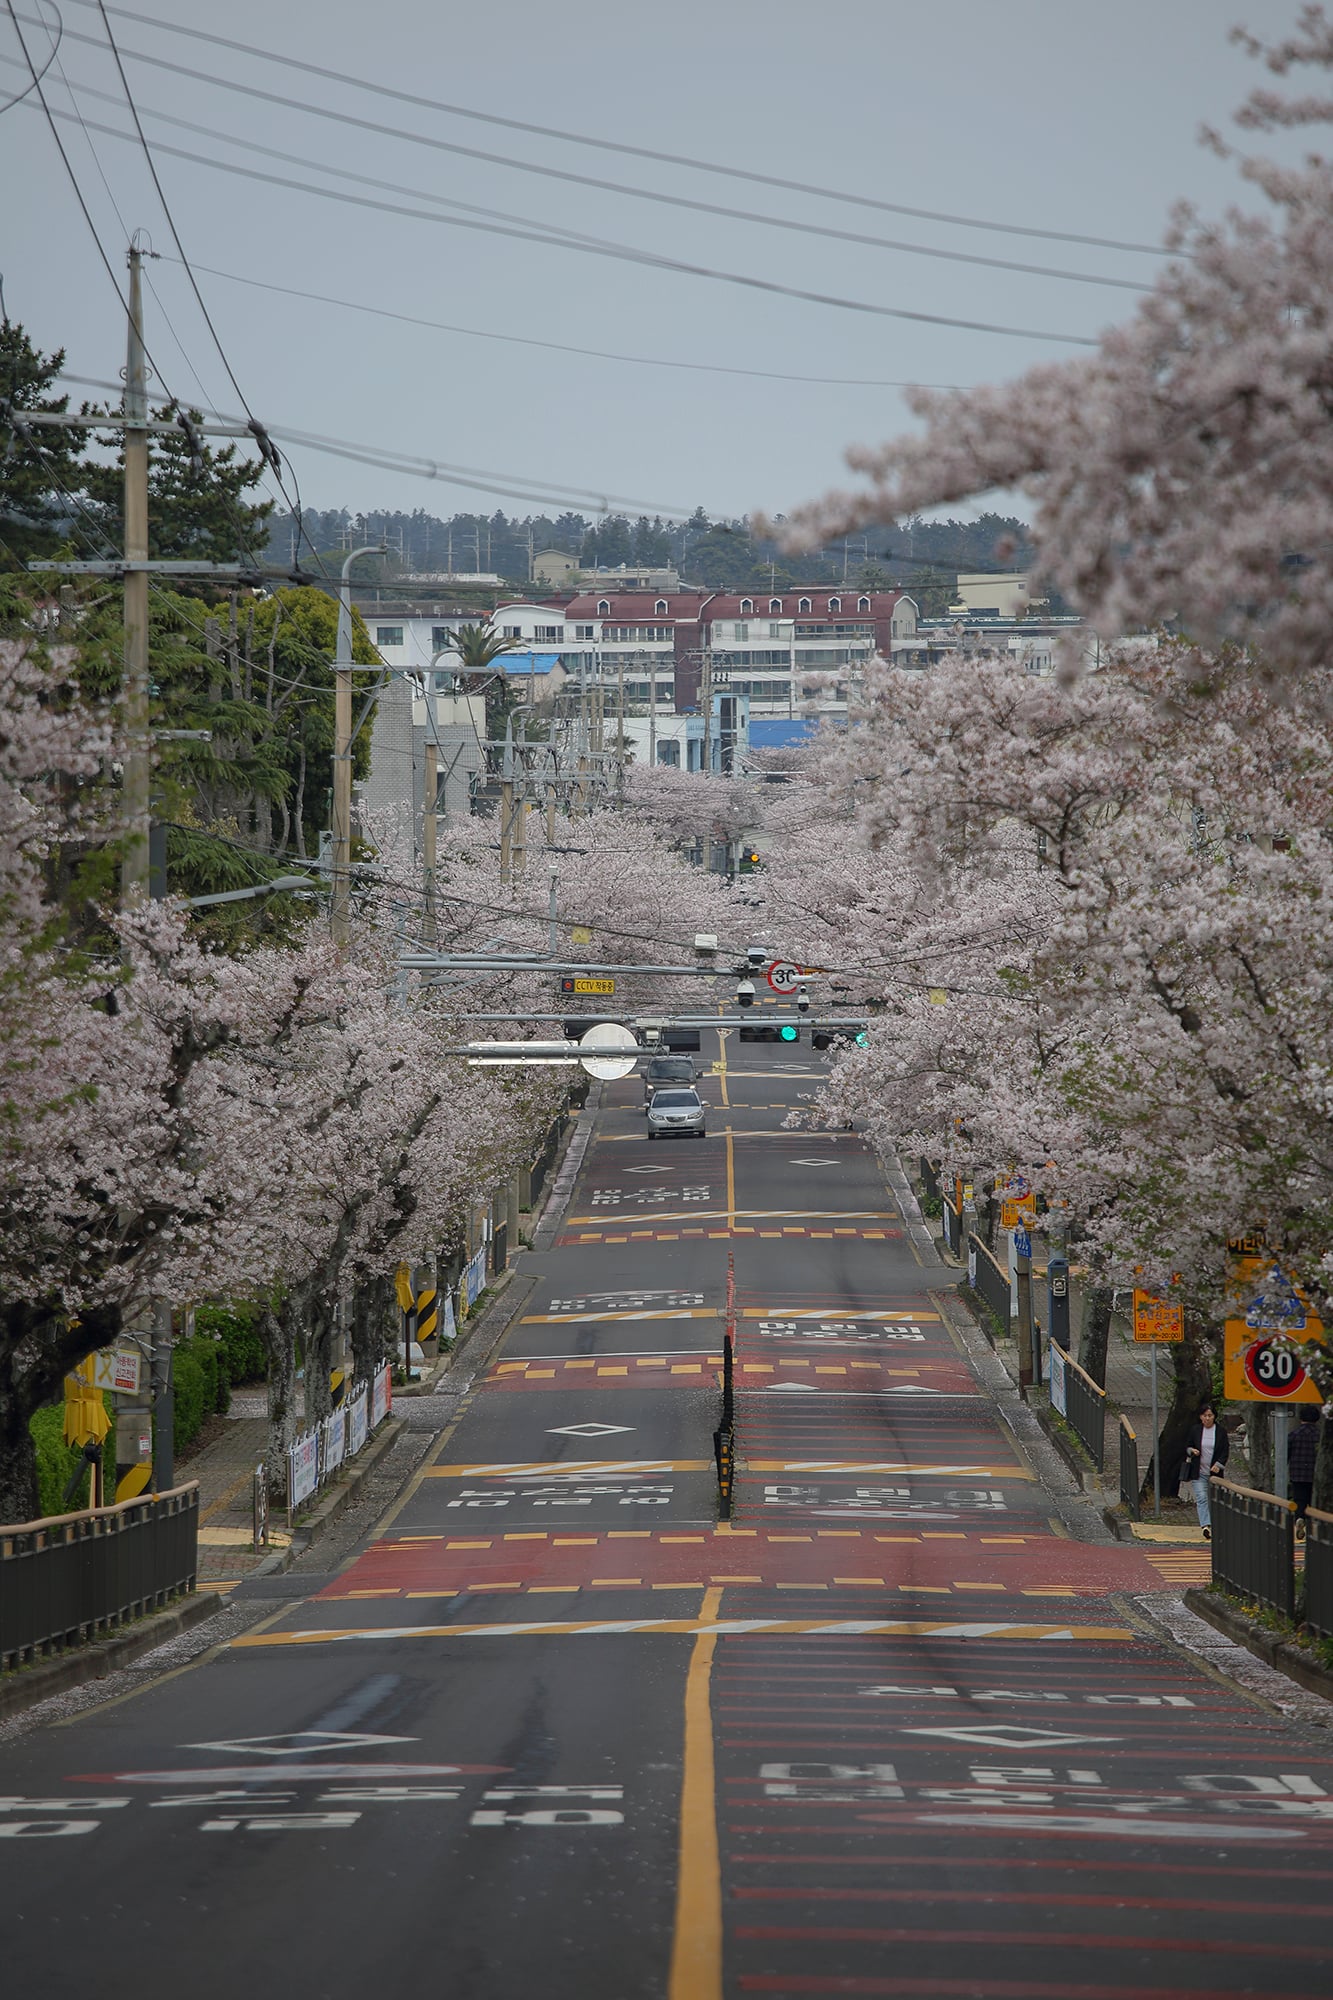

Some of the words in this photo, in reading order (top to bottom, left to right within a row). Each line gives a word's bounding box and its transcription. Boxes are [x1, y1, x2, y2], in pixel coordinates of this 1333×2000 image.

[775, 968, 796, 984] 30
[576, 980, 594, 990] CCTV
[596, 981, 613, 992] 작동중
[759, 1322, 921, 1334] 어린이
[1258, 1350, 1293, 1379] 30
[459, 1484, 674, 1497] 보호구역
[764, 1485, 1005, 1502] 어린이
[447, 1497, 670, 1508] 어린이
[760, 1763, 1328, 1797] 어린이
